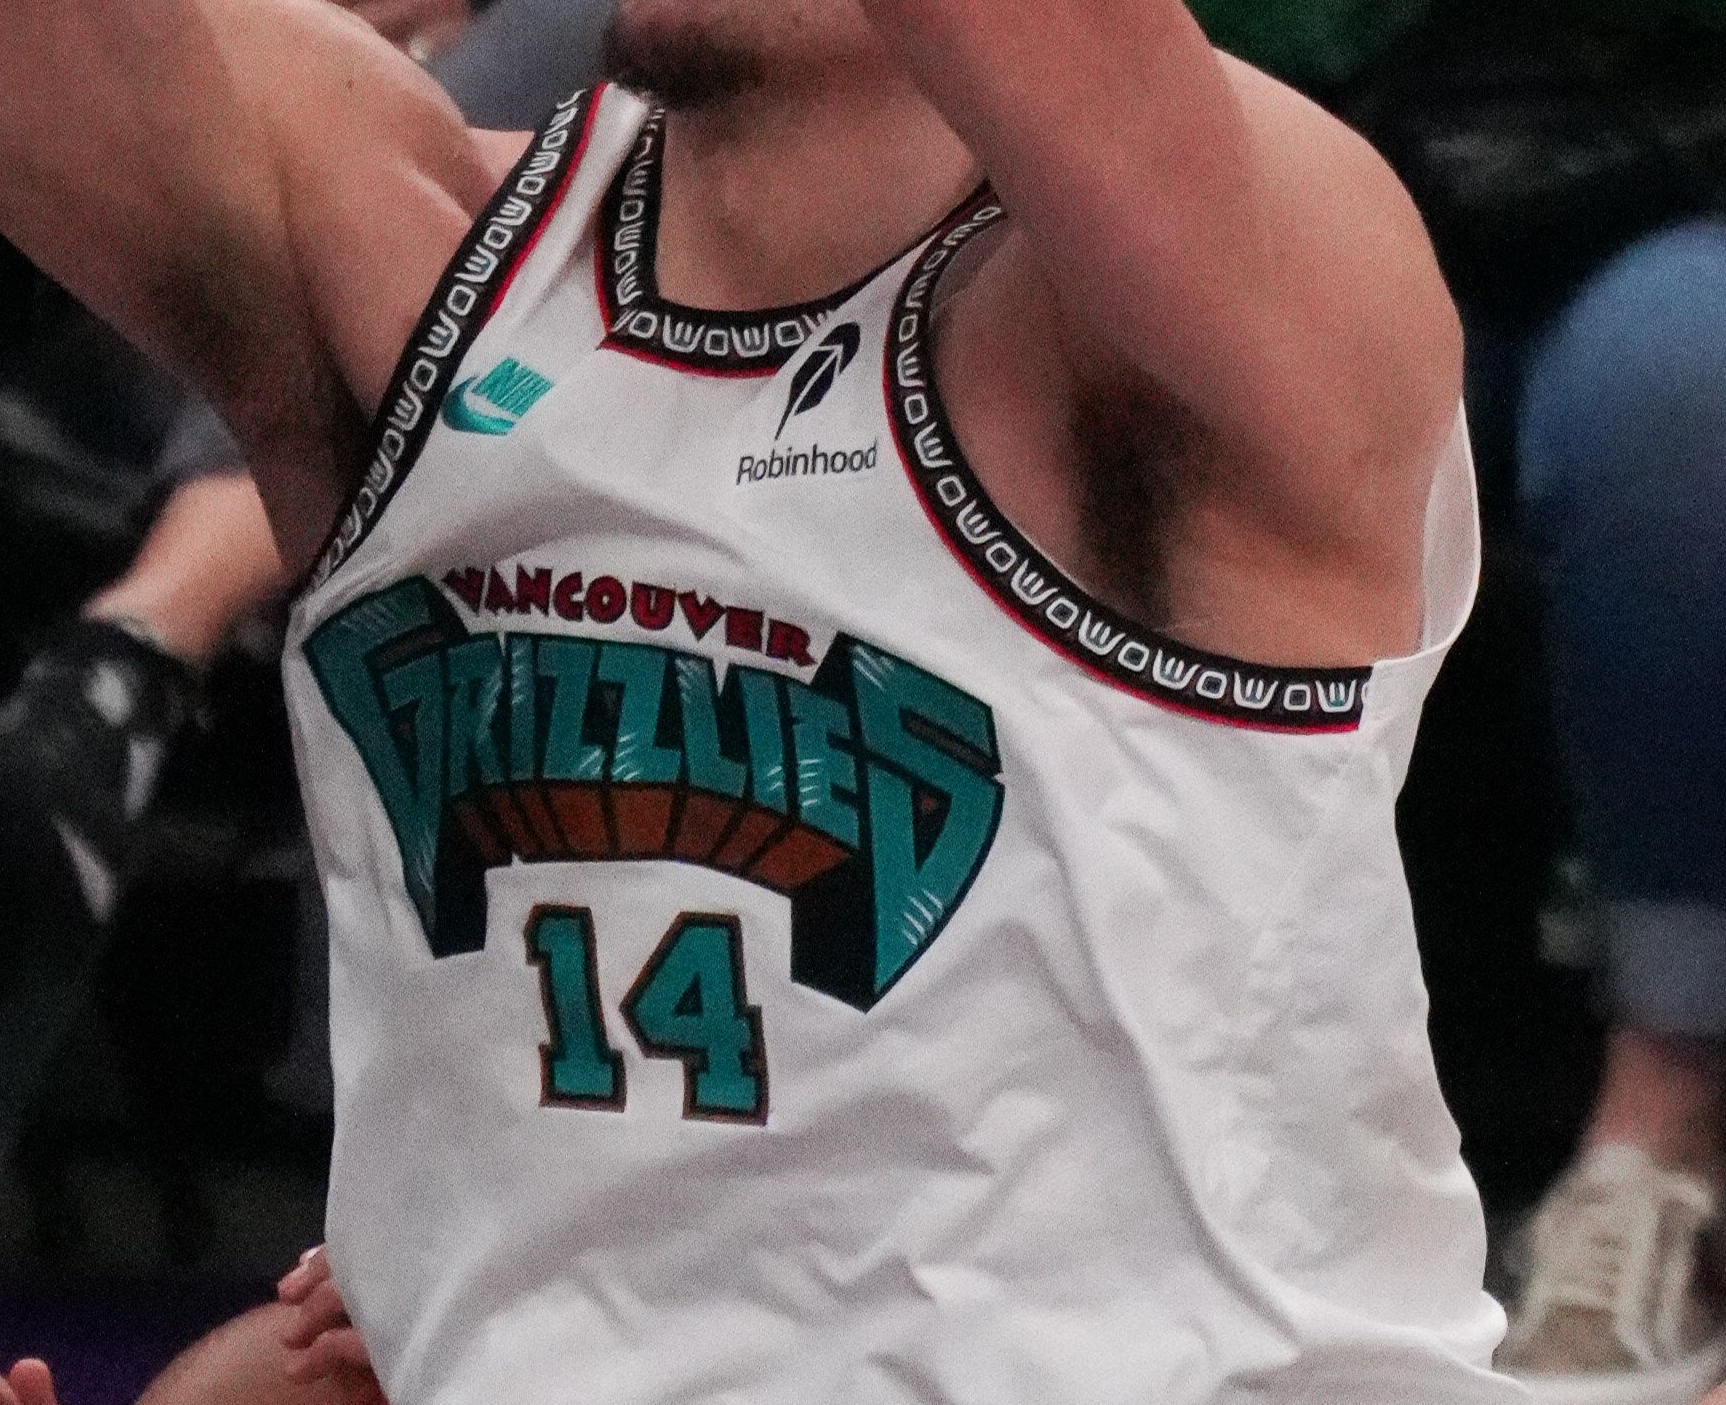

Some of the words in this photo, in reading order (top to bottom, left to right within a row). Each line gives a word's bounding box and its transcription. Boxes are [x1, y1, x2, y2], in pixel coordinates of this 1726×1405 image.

[736, 439, 877, 485] Robinhood
[441, 564, 815, 668] VANCOUVER
[302, 573, 1005, 1015] GRIZZLIES
[524, 903, 769, 1127] 14
